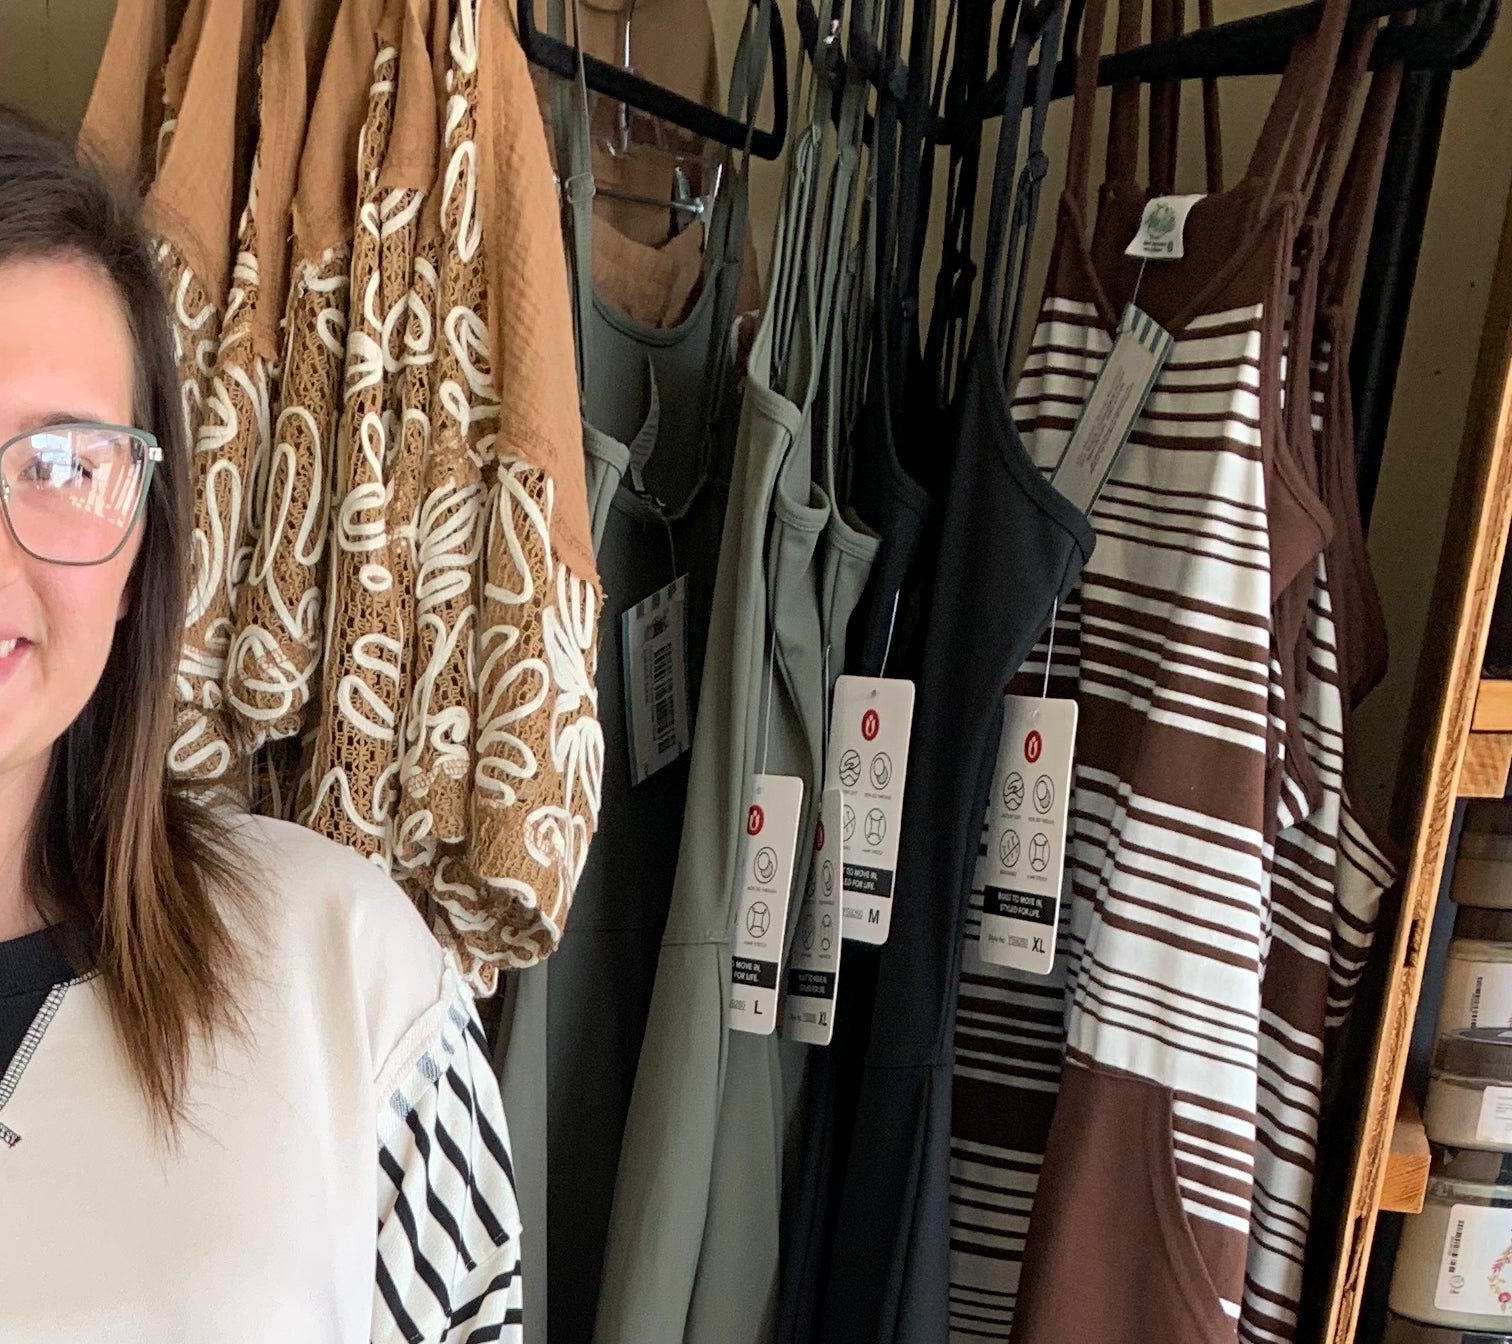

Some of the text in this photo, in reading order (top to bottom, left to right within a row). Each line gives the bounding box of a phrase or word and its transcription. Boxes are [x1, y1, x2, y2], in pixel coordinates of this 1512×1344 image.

[868, 908, 880, 924] M
[1032, 937, 1045, 954] XL
[754, 999, 763, 1015] L
